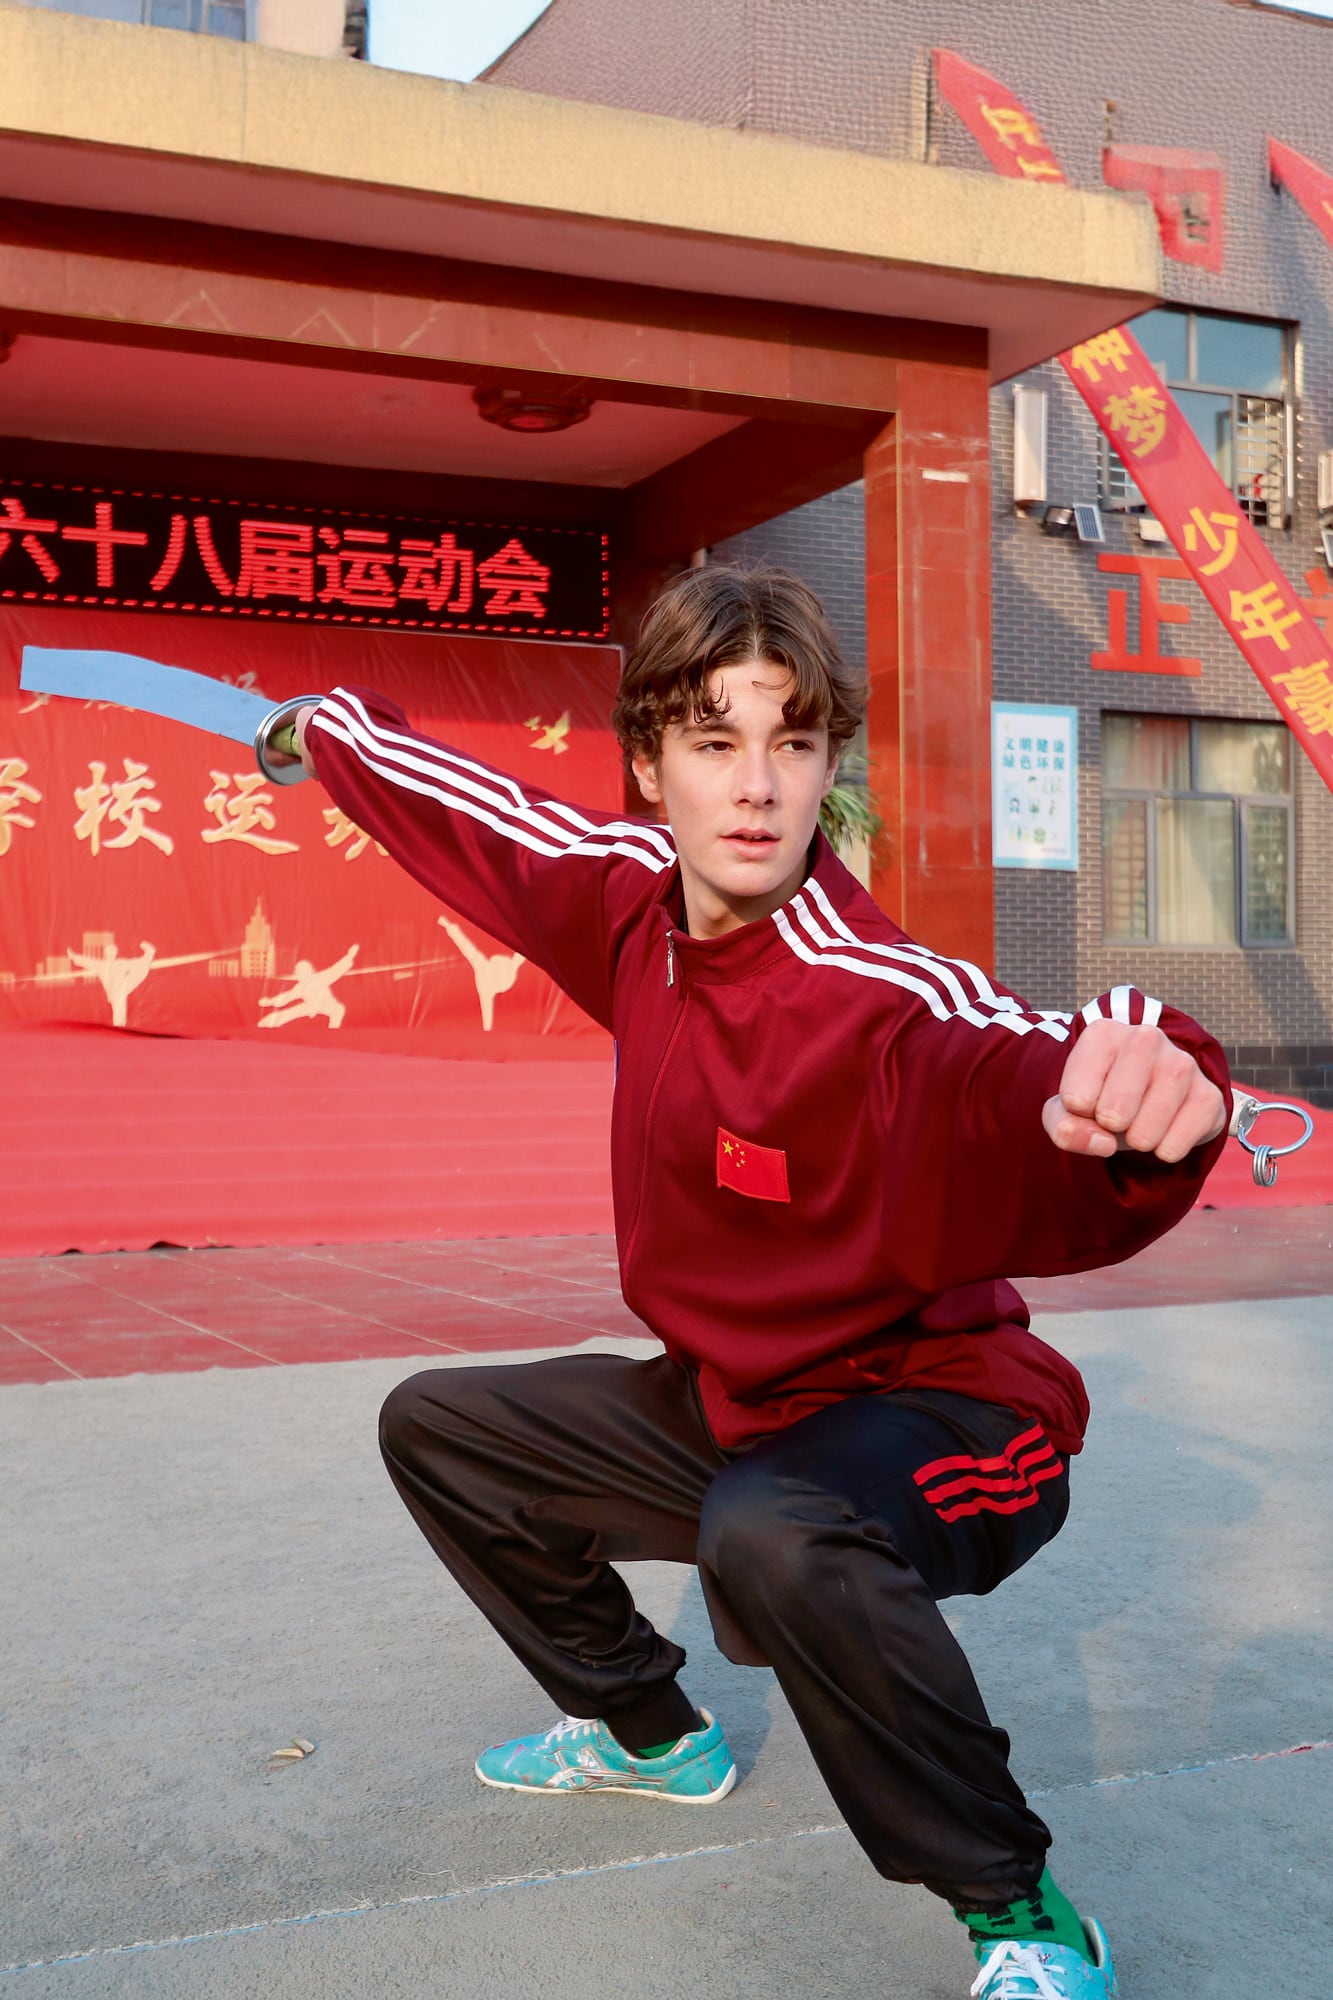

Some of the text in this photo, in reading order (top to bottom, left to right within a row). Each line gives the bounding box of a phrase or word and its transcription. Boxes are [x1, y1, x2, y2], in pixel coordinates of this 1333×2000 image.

[0, 498, 550, 617] 六十八届运动会
[1090, 553, 1203, 677] 正
[1003, 754, 1065, 770] 绿色环保
[1004, 737, 1065, 753] 文明健康
